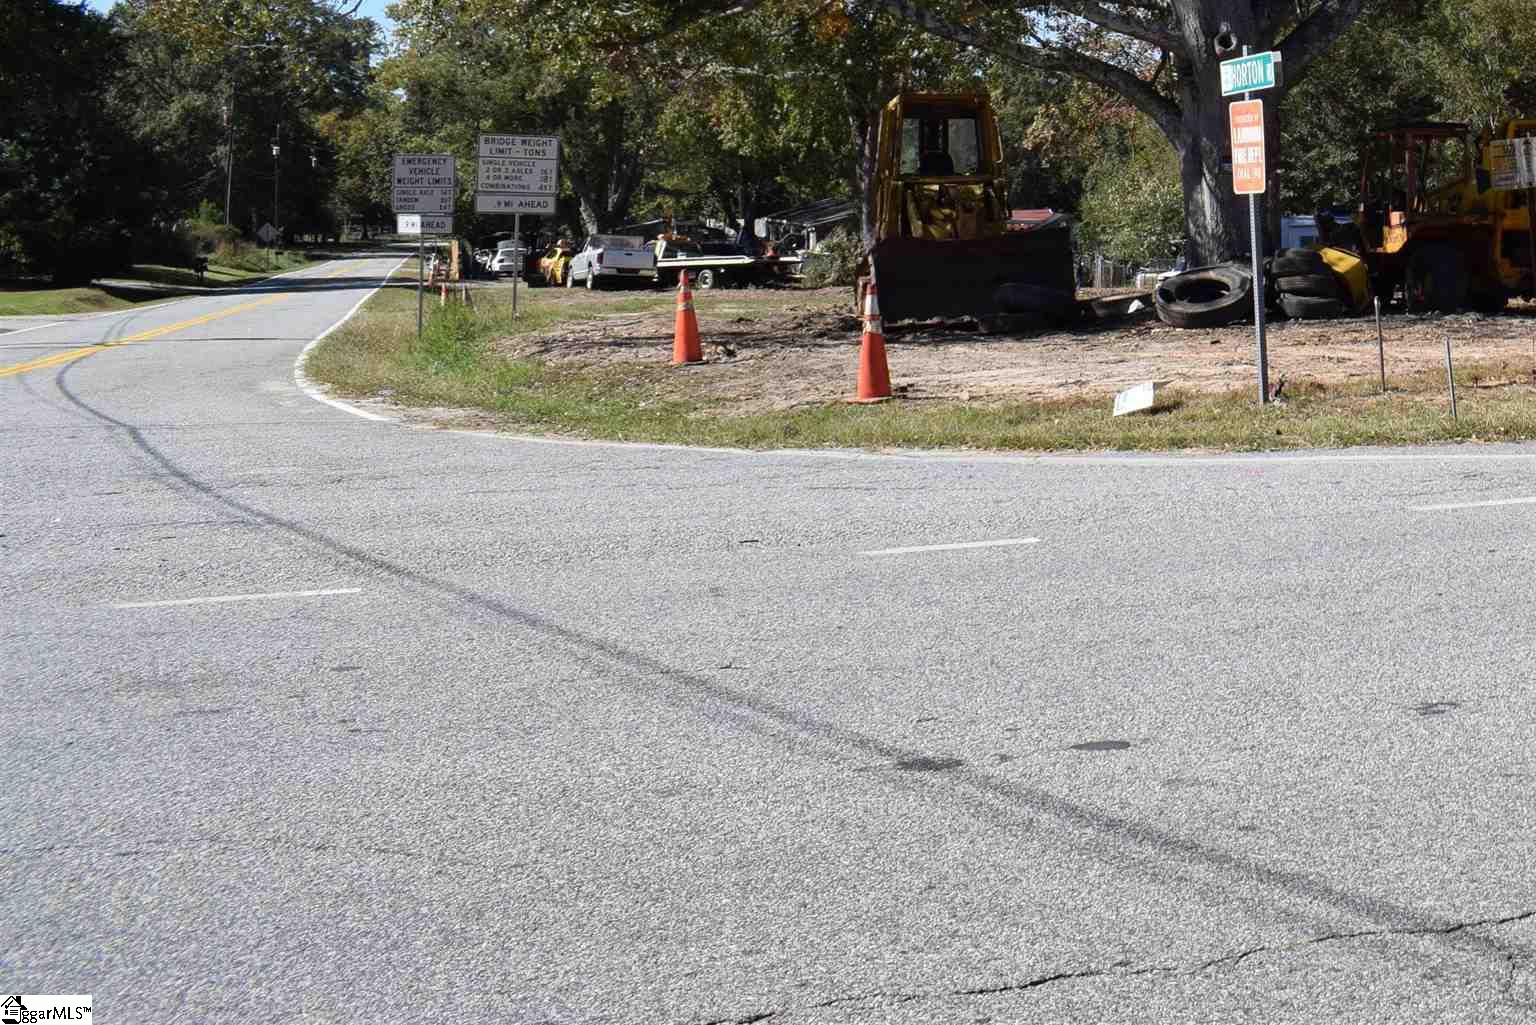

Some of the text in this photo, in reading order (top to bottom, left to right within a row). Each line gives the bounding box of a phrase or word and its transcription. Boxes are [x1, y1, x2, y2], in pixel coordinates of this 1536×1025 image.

[1232, 60, 1265, 89] HORTON
[484, 136, 553, 147] BRIDGE WEIGHT
[489, 147, 512, 156] LIMIT
[522, 147, 547, 157] TONS
[402, 157, 447, 166] EMERGENCY
[408, 167, 441, 176] VEHICLE
[396, 177, 453, 186] WEIGHT LIMITS
[518, 200, 549, 209] AHEAD
[421, 220, 446, 229] AHEAD
